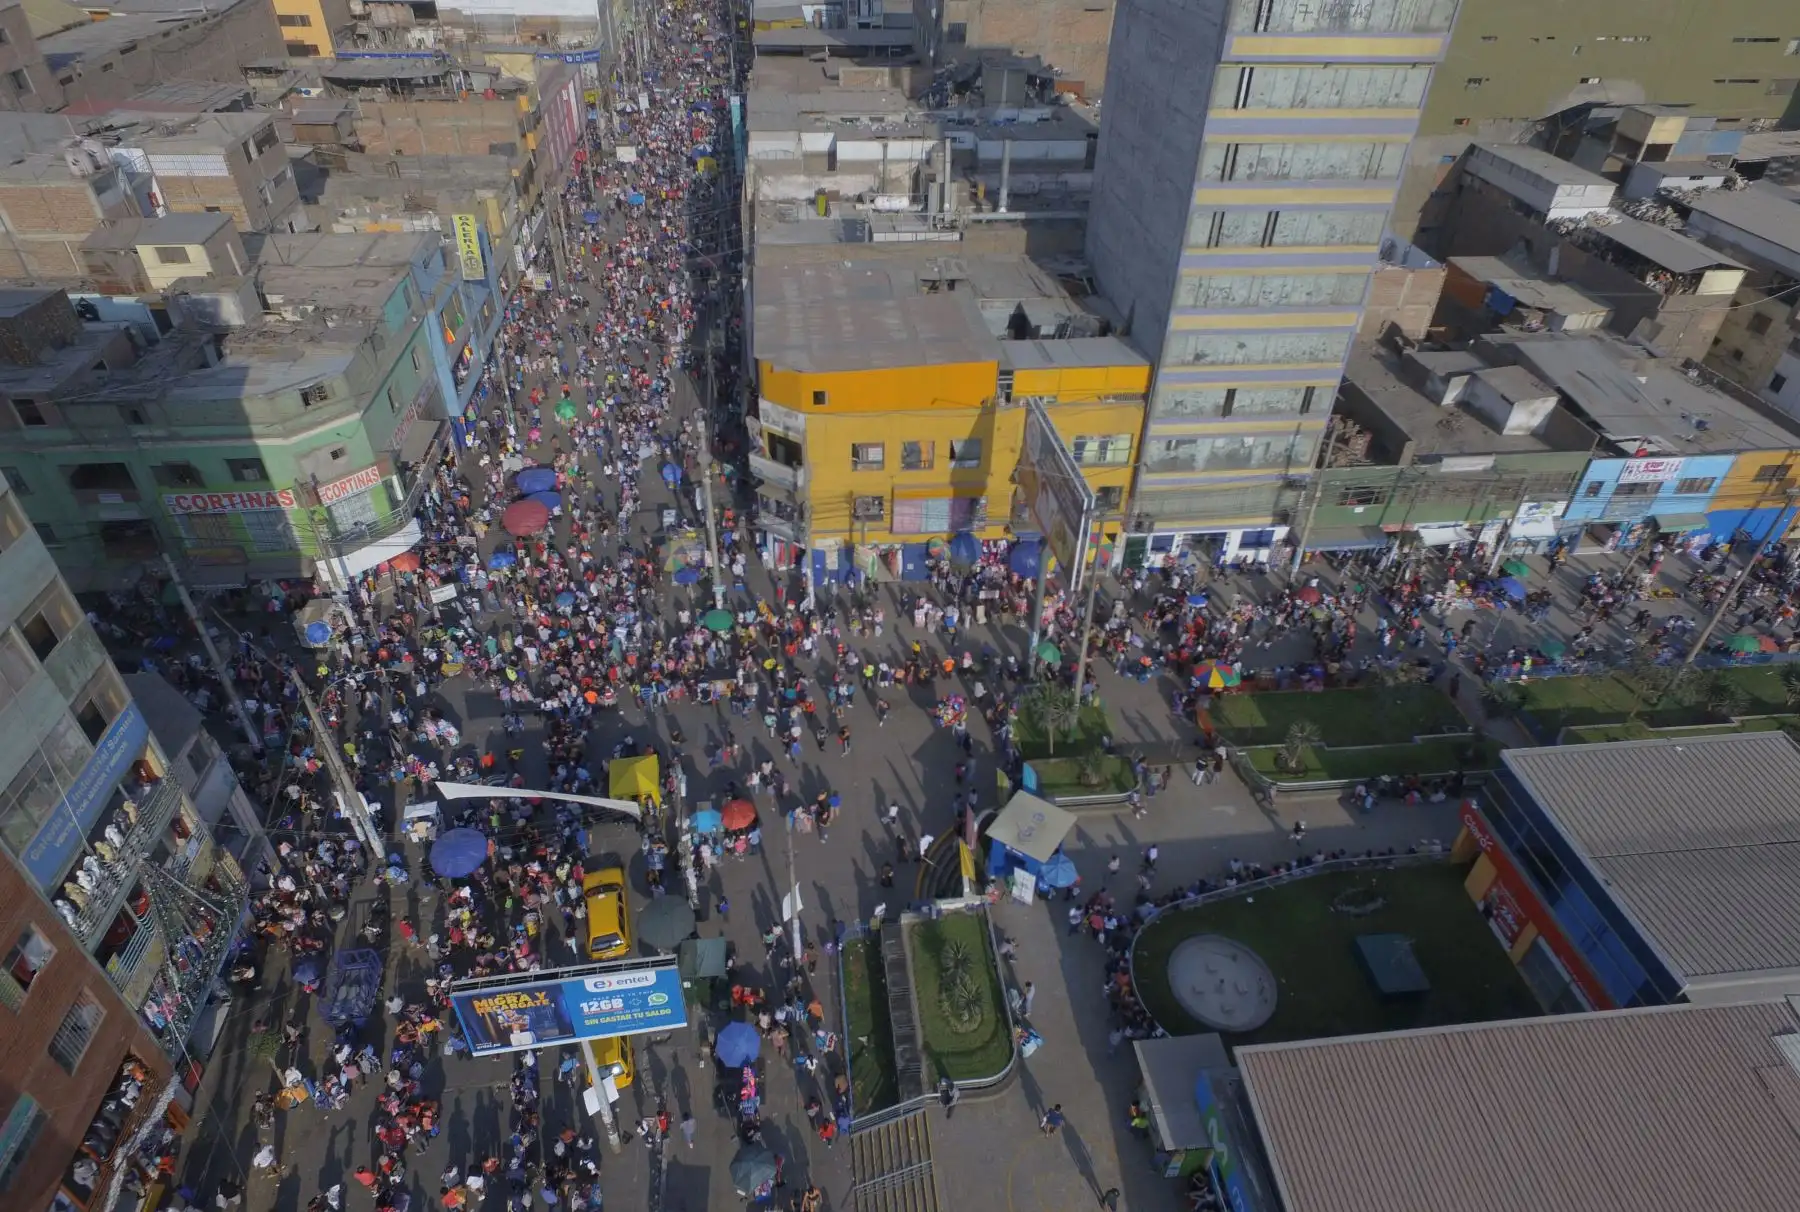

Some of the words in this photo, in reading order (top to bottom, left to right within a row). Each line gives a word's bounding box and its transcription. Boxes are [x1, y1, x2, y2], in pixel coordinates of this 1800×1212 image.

[459, 215, 475, 255] GALERIA
[324, 467, 381, 502] CORTINAS
[174, 489, 295, 512] CORTINAS
[616, 975, 650, 986] entel
[473, 994, 532, 1011] MIGRA
[580, 998, 624, 1012] 12GB
[584, 1017, 599, 1026] SIN
[600, 1013, 632, 1024] GASTAR
[645, 1008, 672, 1018] SALDO
